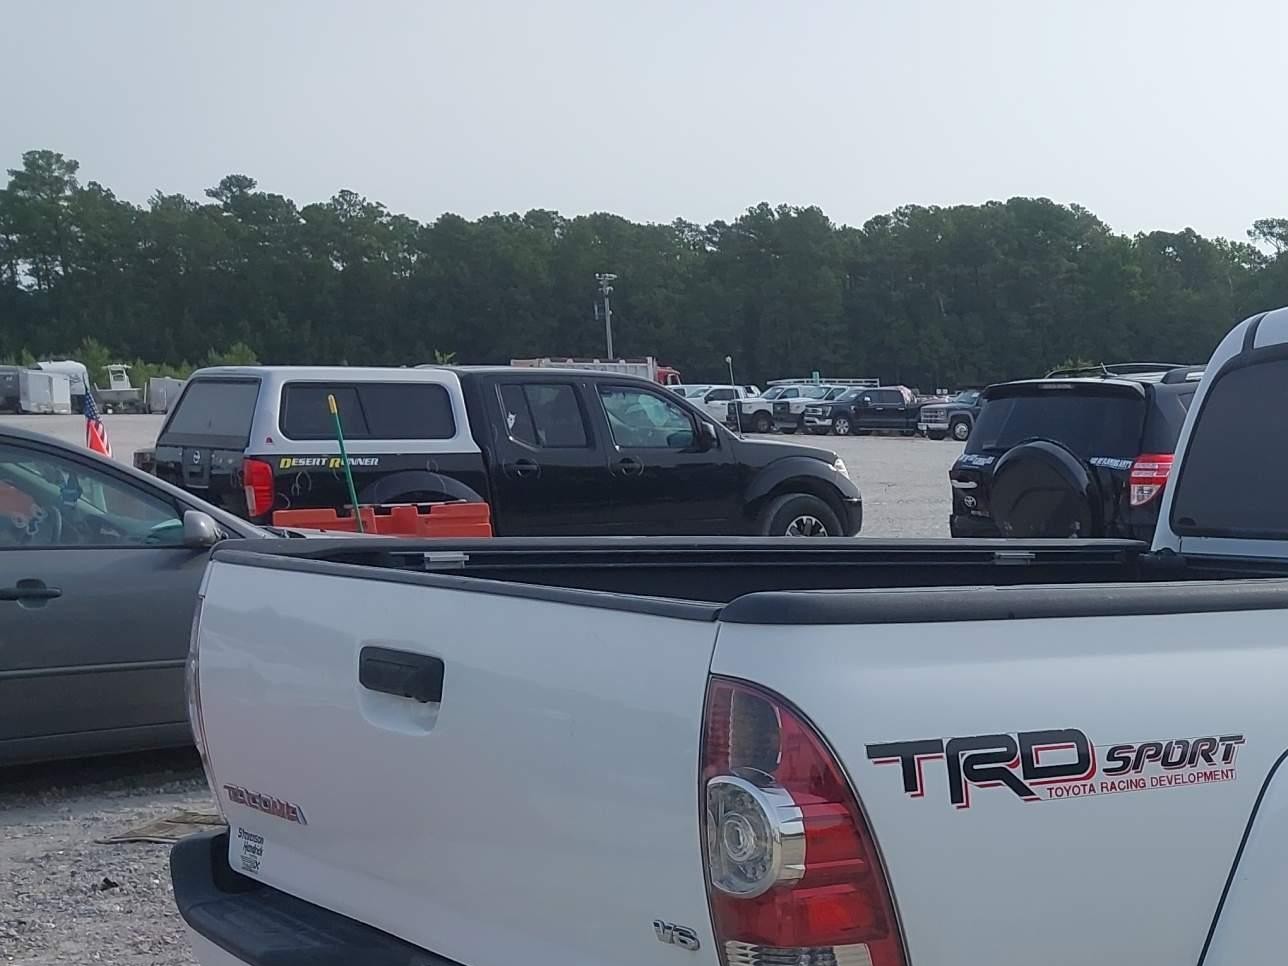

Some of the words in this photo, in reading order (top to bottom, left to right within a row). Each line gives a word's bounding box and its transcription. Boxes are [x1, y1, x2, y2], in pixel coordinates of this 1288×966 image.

[280, 457, 328, 469] DESERT
[865, 727, 1097, 809] TRD
[1102, 734, 1246, 777] SPORT
[1047, 783, 1096, 799] TOYOTA
[1100, 777, 1147, 793] RACING
[1150, 768, 1236, 787] DEVELOPMENT
[223, 783, 307, 826] TACOMA
[653, 919, 701, 952] V6
